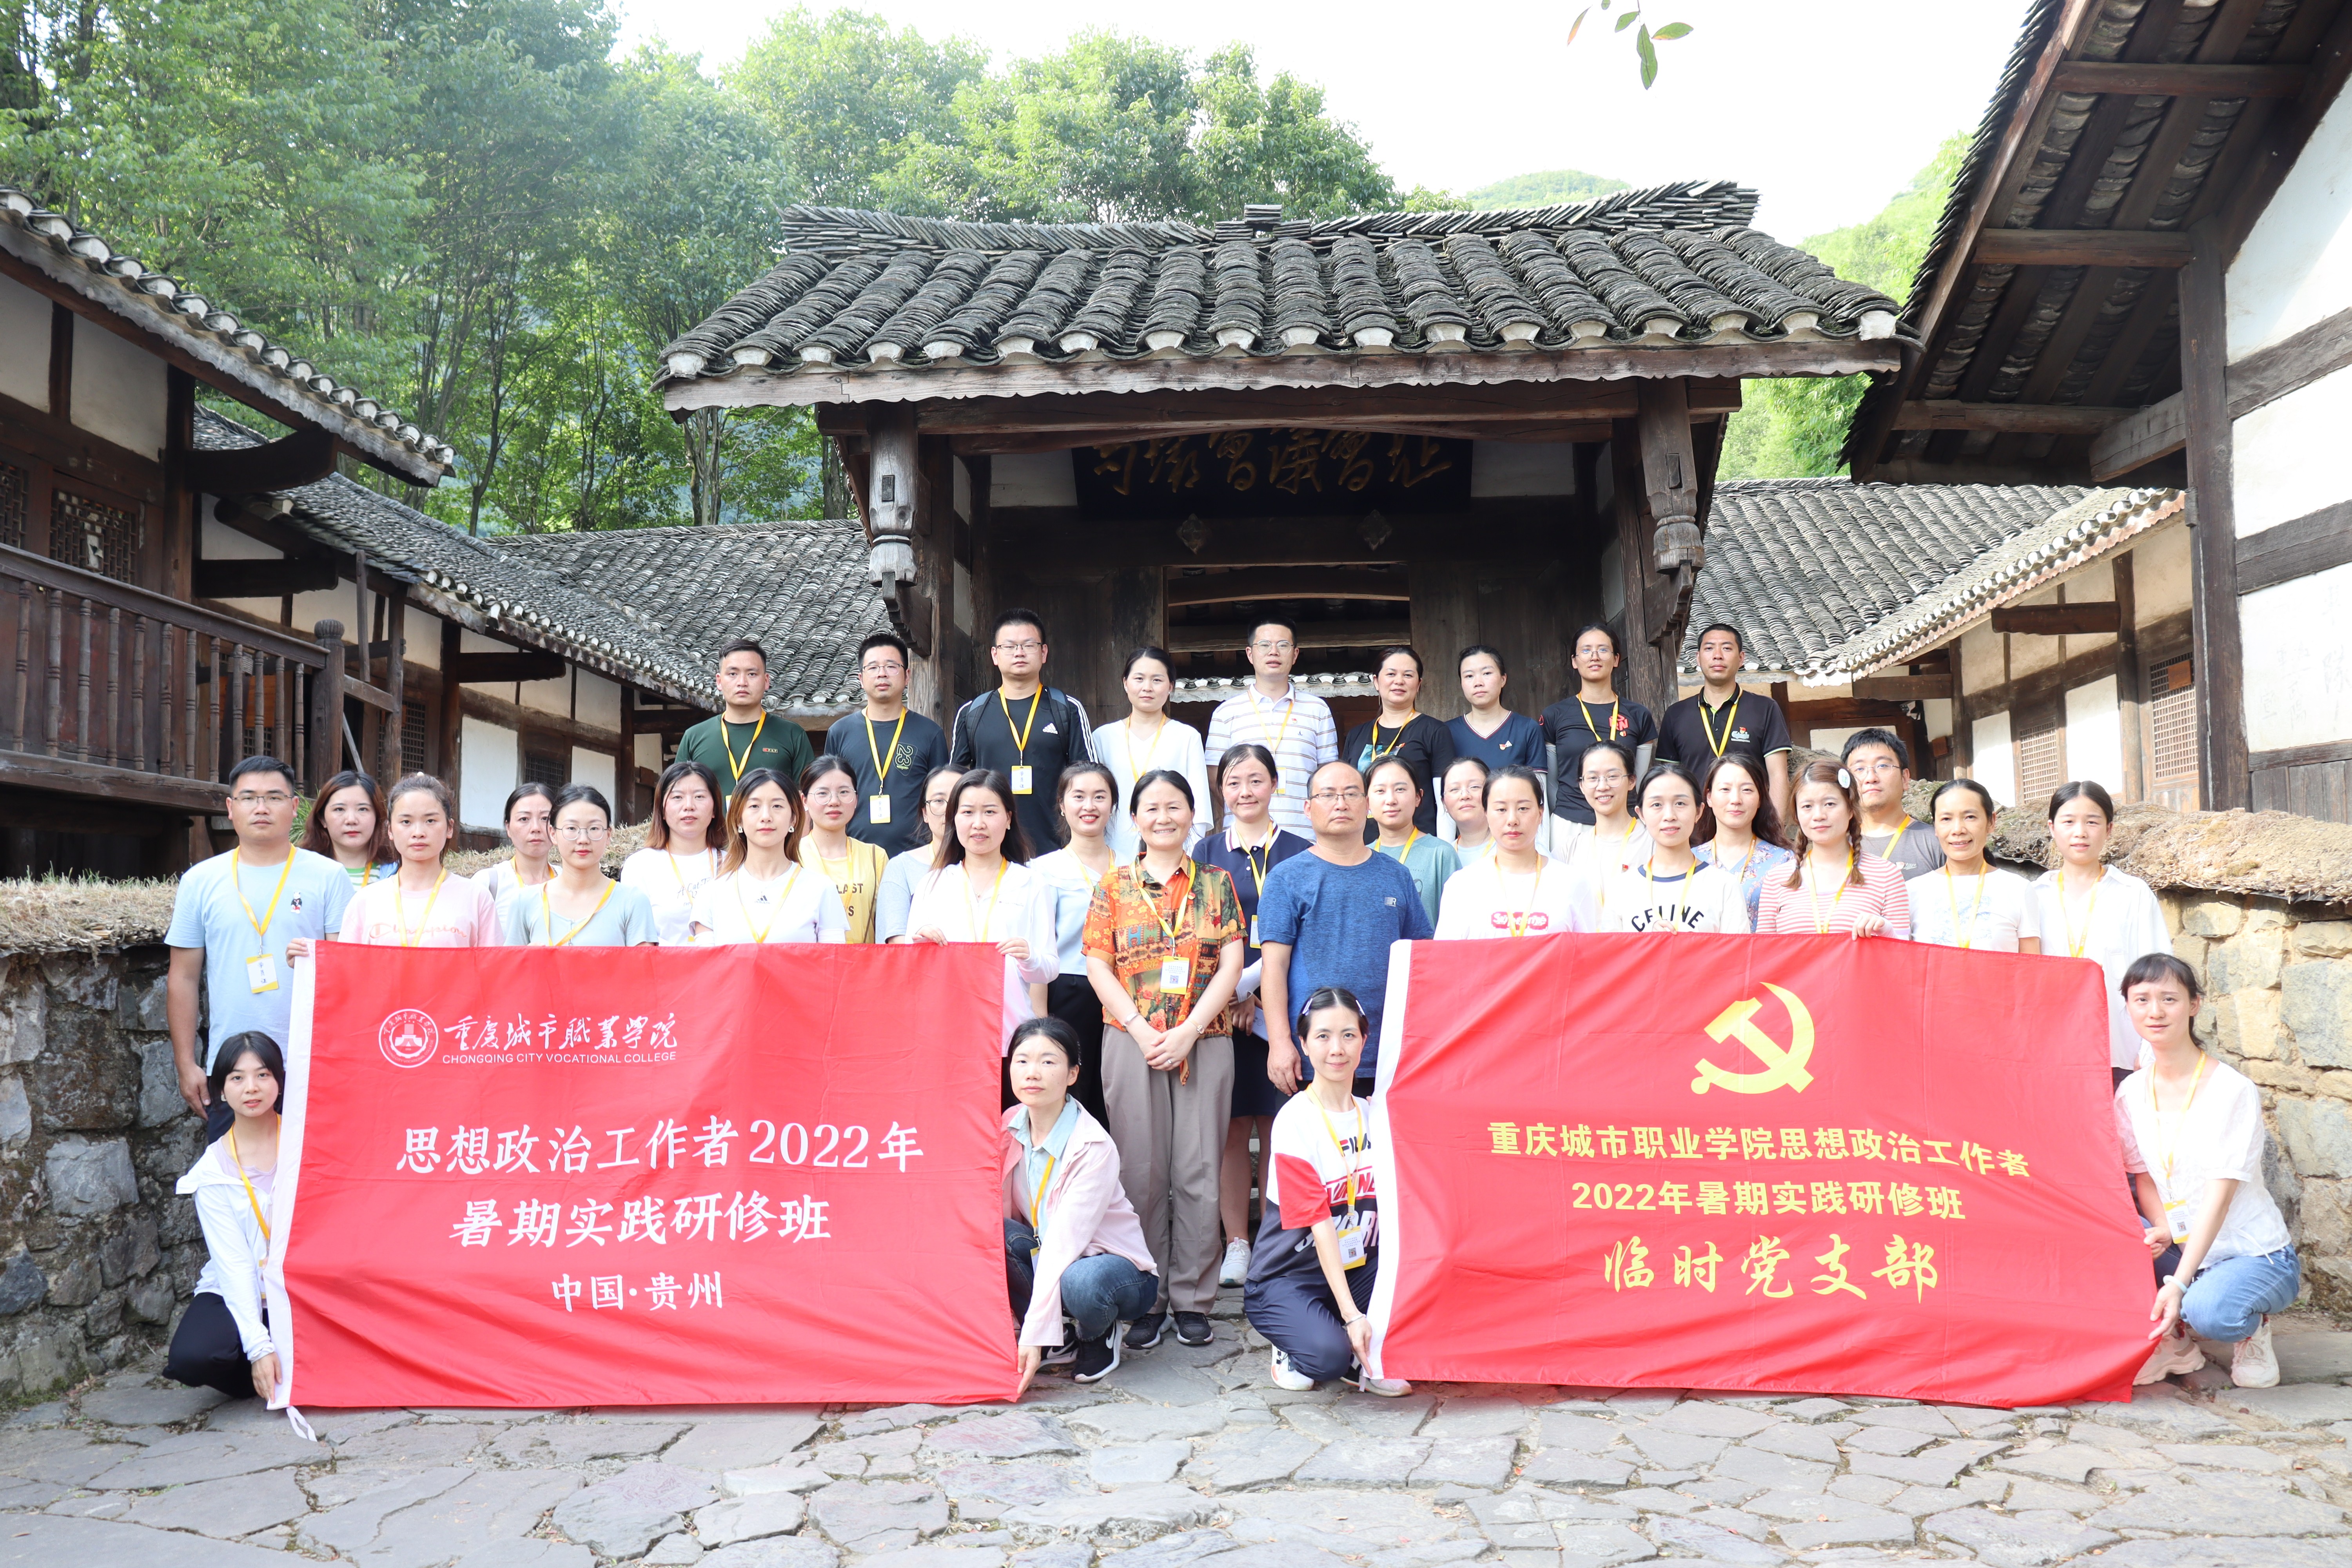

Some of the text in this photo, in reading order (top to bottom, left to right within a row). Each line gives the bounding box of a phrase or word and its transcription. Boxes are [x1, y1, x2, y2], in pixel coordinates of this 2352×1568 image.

[895, 744, 913, 766] 23
[443, 1051, 676, 1063] CHONGQING CITY VOCATIONAL COLLEGE
[396, 1115, 924, 1174] 思想政治工作者2022年
[1488, 1122, 2030, 1176] 重庆城市职业学院思想政治工作者
[449, 1190, 831, 1248] 暑期实践研修班
[1572, 1181, 1965, 1220] 2022年暑期实践研修班
[1604, 1234, 1938, 1303] 临时党支部
